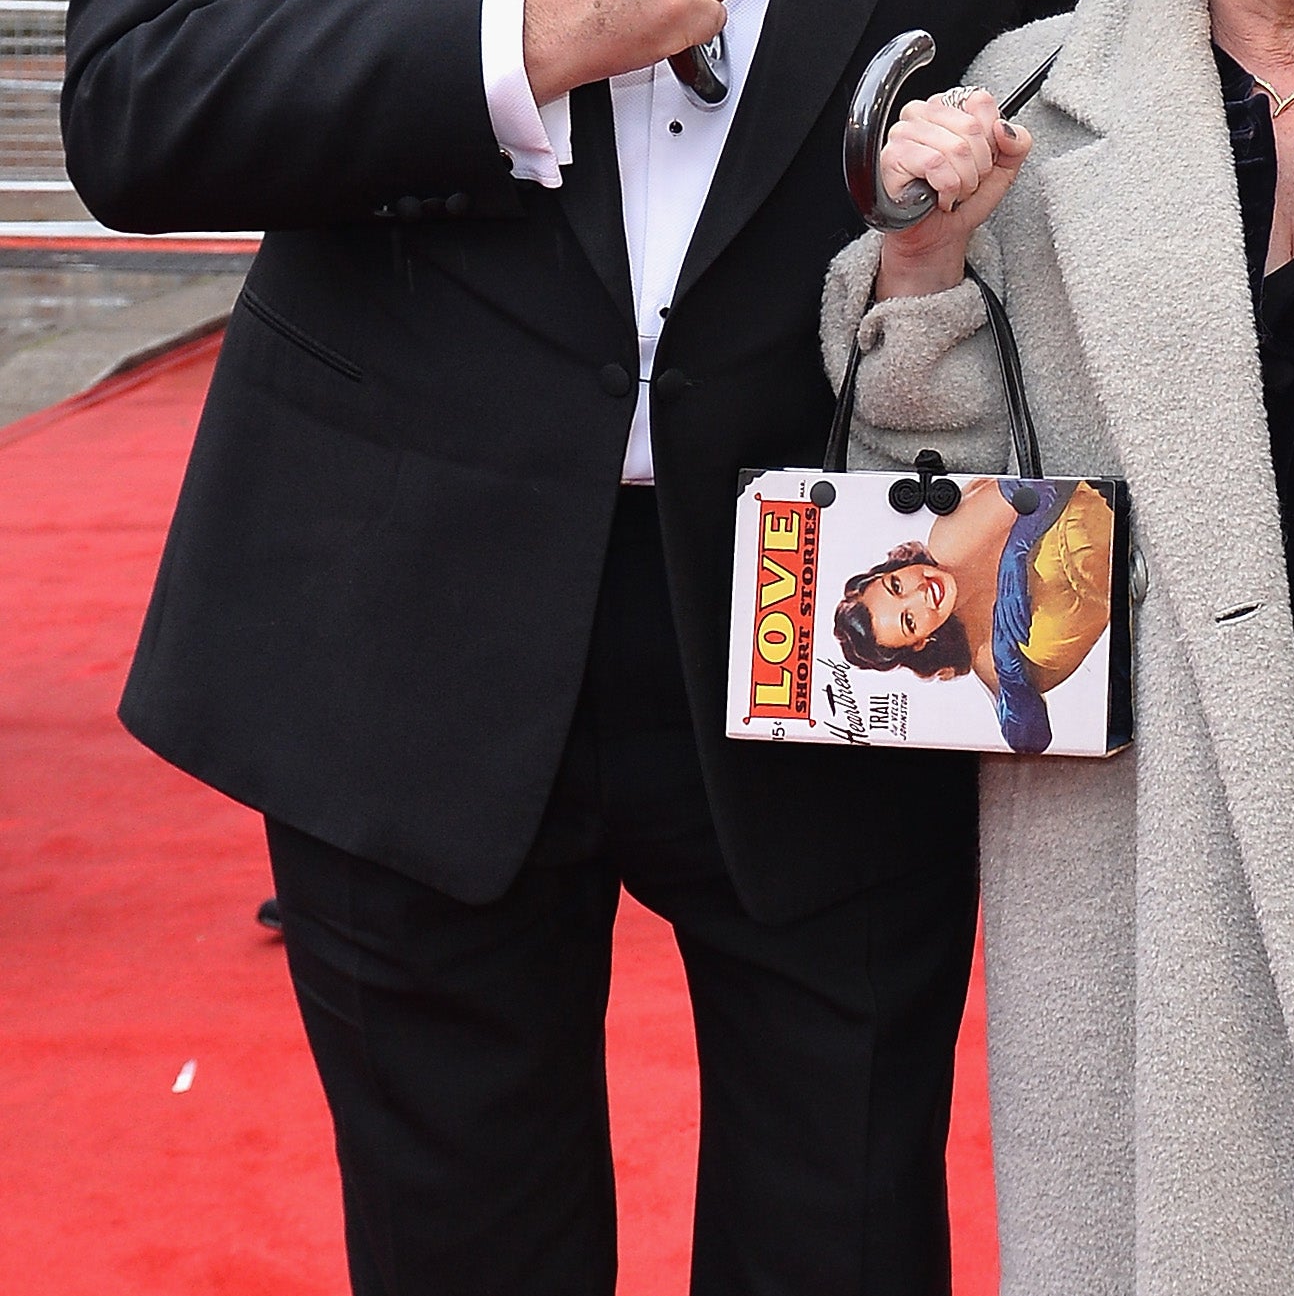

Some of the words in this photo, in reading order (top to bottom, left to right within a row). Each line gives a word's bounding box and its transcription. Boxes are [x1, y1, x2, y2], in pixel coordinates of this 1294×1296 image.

[754, 509, 800, 709] LOVE
[800, 507, 817, 617] STORIES
[796, 626, 810, 713] SHORT
[869, 693, 890, 730] TRAIL
